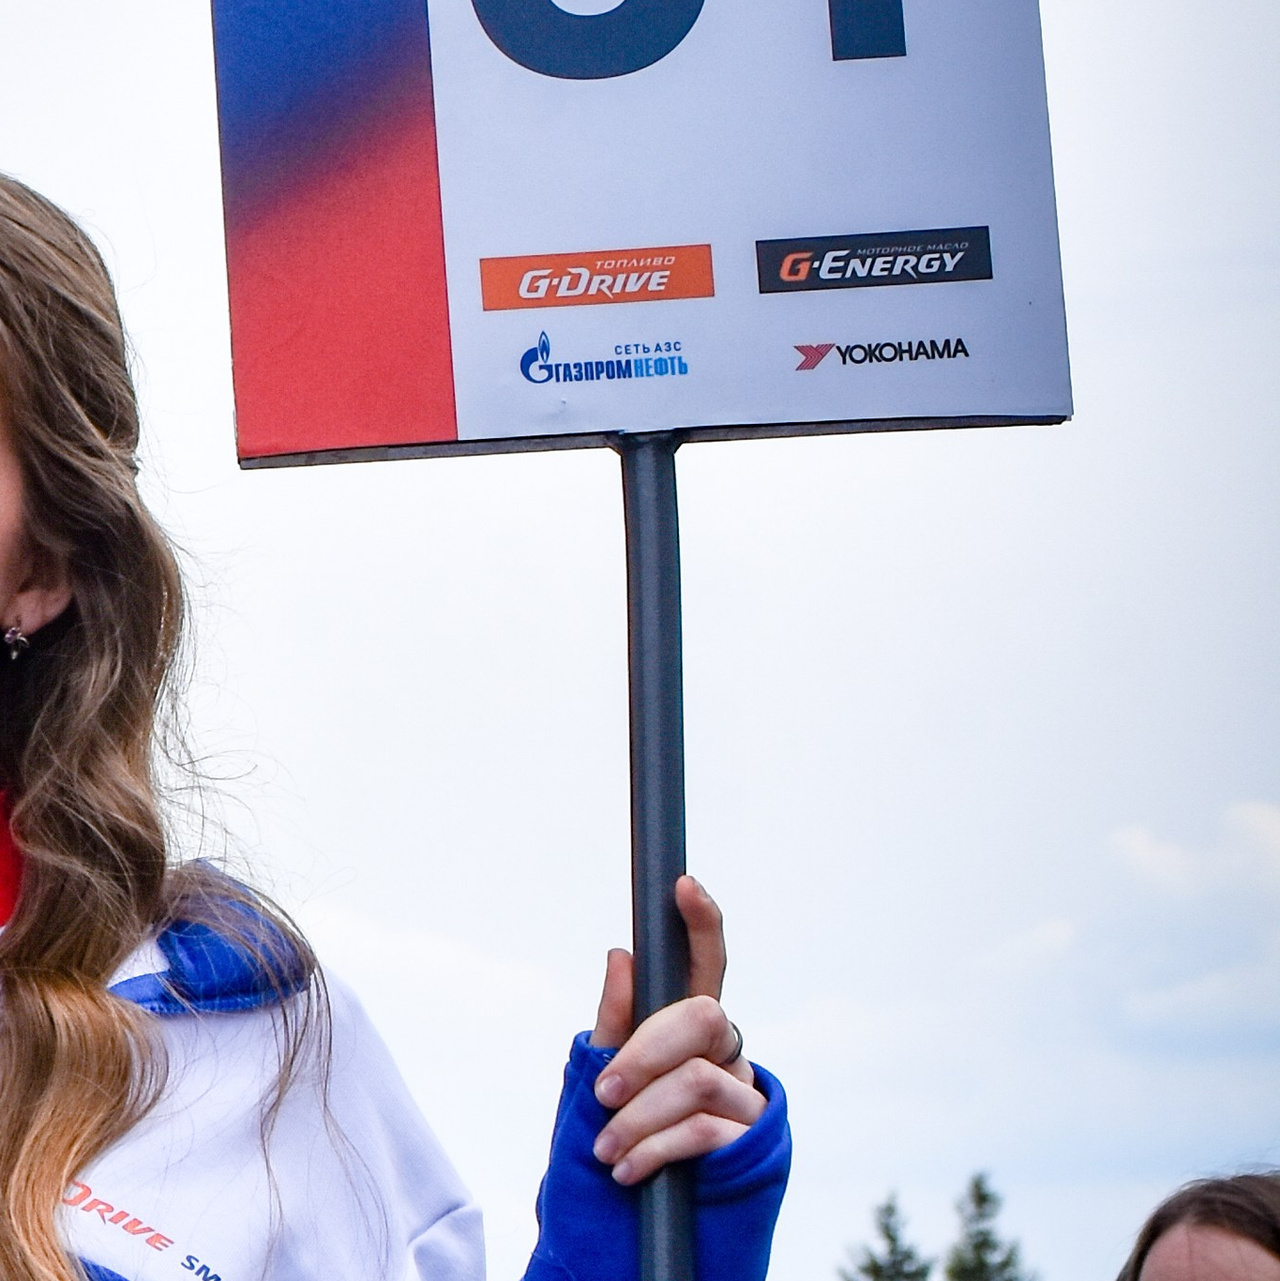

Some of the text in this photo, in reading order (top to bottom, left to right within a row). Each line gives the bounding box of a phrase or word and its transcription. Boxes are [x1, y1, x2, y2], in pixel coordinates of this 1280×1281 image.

[595, 256, 676, 270] ТОПЛИВО
[614, 341, 682, 355] СЕТЬ АЗС
[835, 337, 970, 365] YOKOHAMA
[61, 1179, 175, 1251] DRIVE
